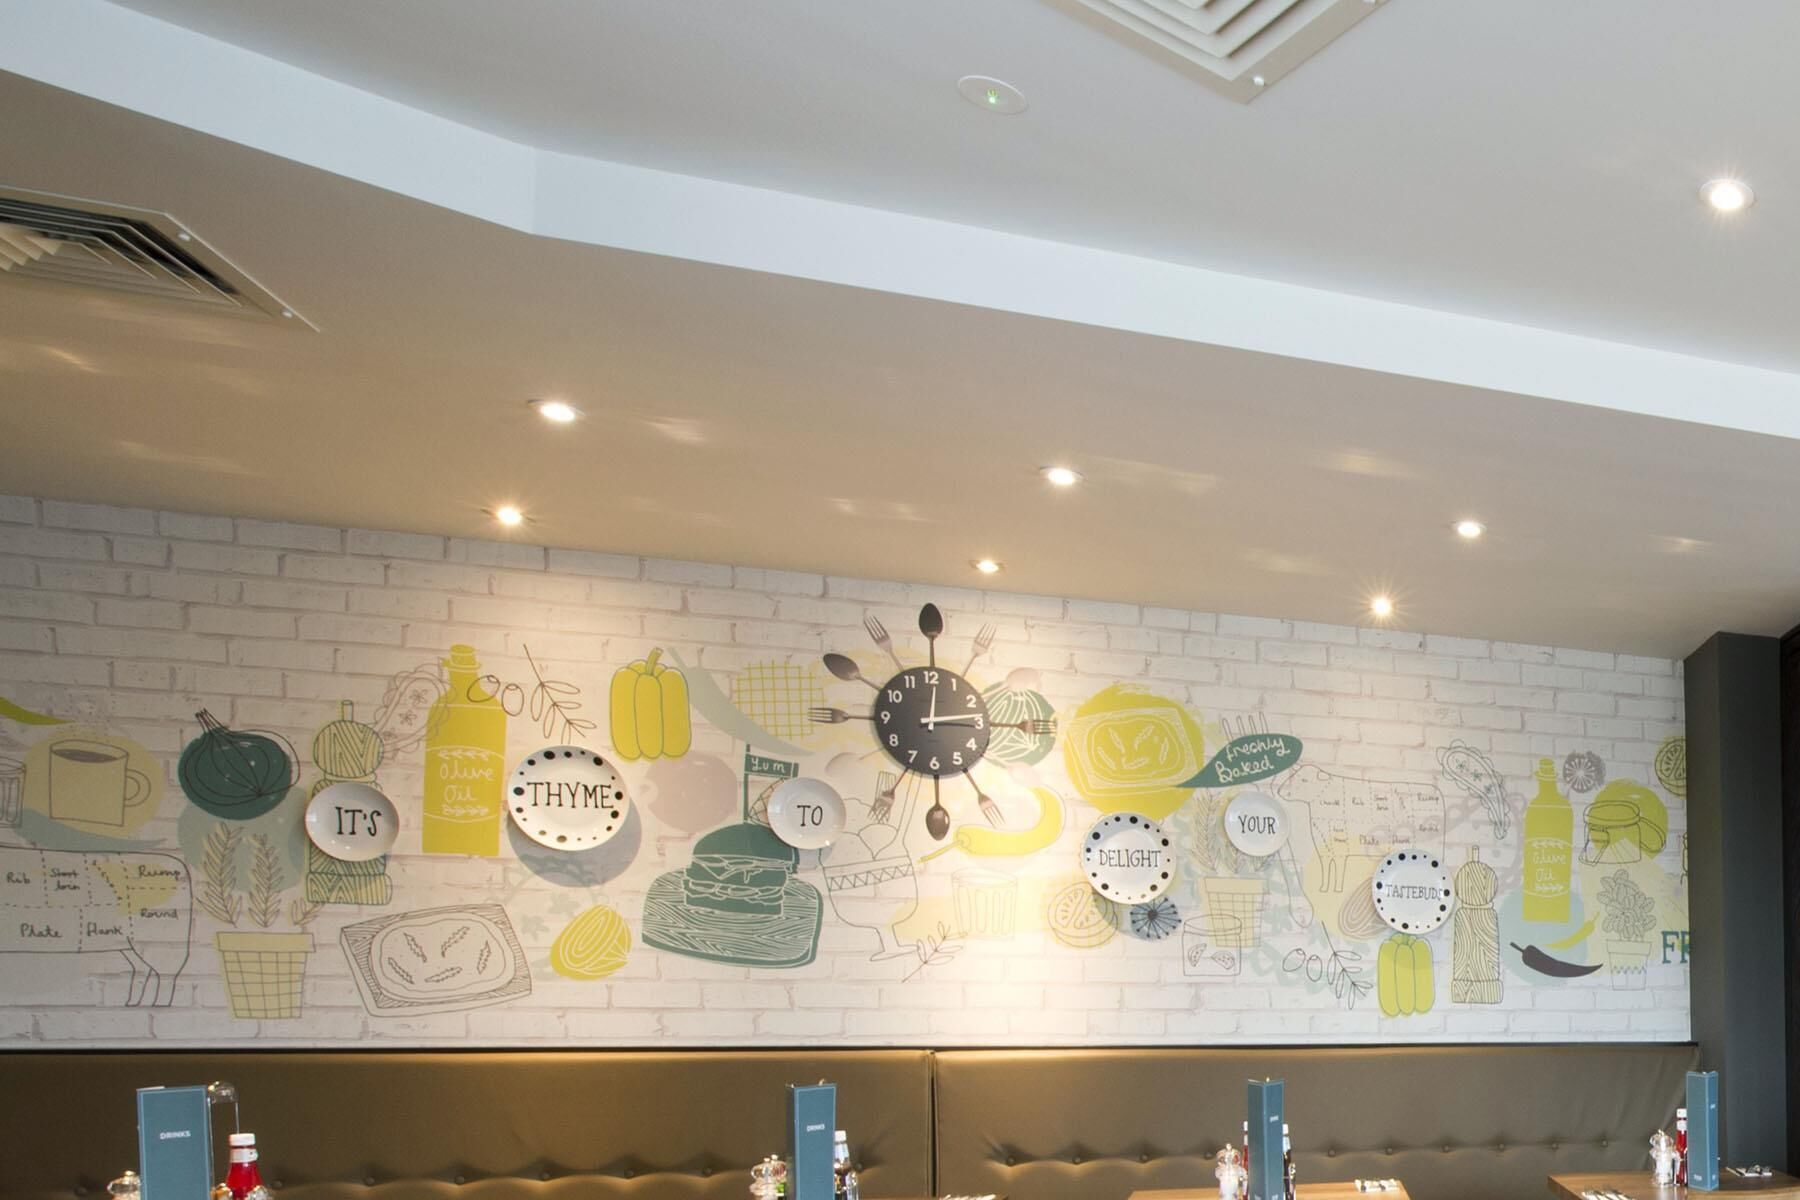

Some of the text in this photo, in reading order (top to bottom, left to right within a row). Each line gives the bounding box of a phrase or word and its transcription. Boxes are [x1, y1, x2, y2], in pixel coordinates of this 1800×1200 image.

[905, 675, 916, 689] 11
[923, 671, 940, 685] 12
[951, 678, 958, 691] 1
[888, 689, 903, 703] 10
[966, 695, 977, 708] 2
[880, 711, 891, 725] 9
[974, 716, 984, 730] 3
[889, 734, 899, 747] 8
[965, 737, 977, 751] 4
[908, 750, 918, 764] 7
[929, 756, 940, 770] 6
[952, 752, 963, 765] 5
[1214, 755, 1275, 784] Baked
[527, 781, 614, 809] THYME
[335, 806, 382, 837] IT'S
[797, 804, 823, 827] TO
[1238, 814, 1276, 834] YOUR
[1099, 849, 1161, 868] DELIGHT
[6, 872, 31, 884] Rib
[1385, 884, 1443, 901] TASTEBUDS
[20, 923, 63, 938] Plate
[160, 1130, 191, 1140] DRINKS
